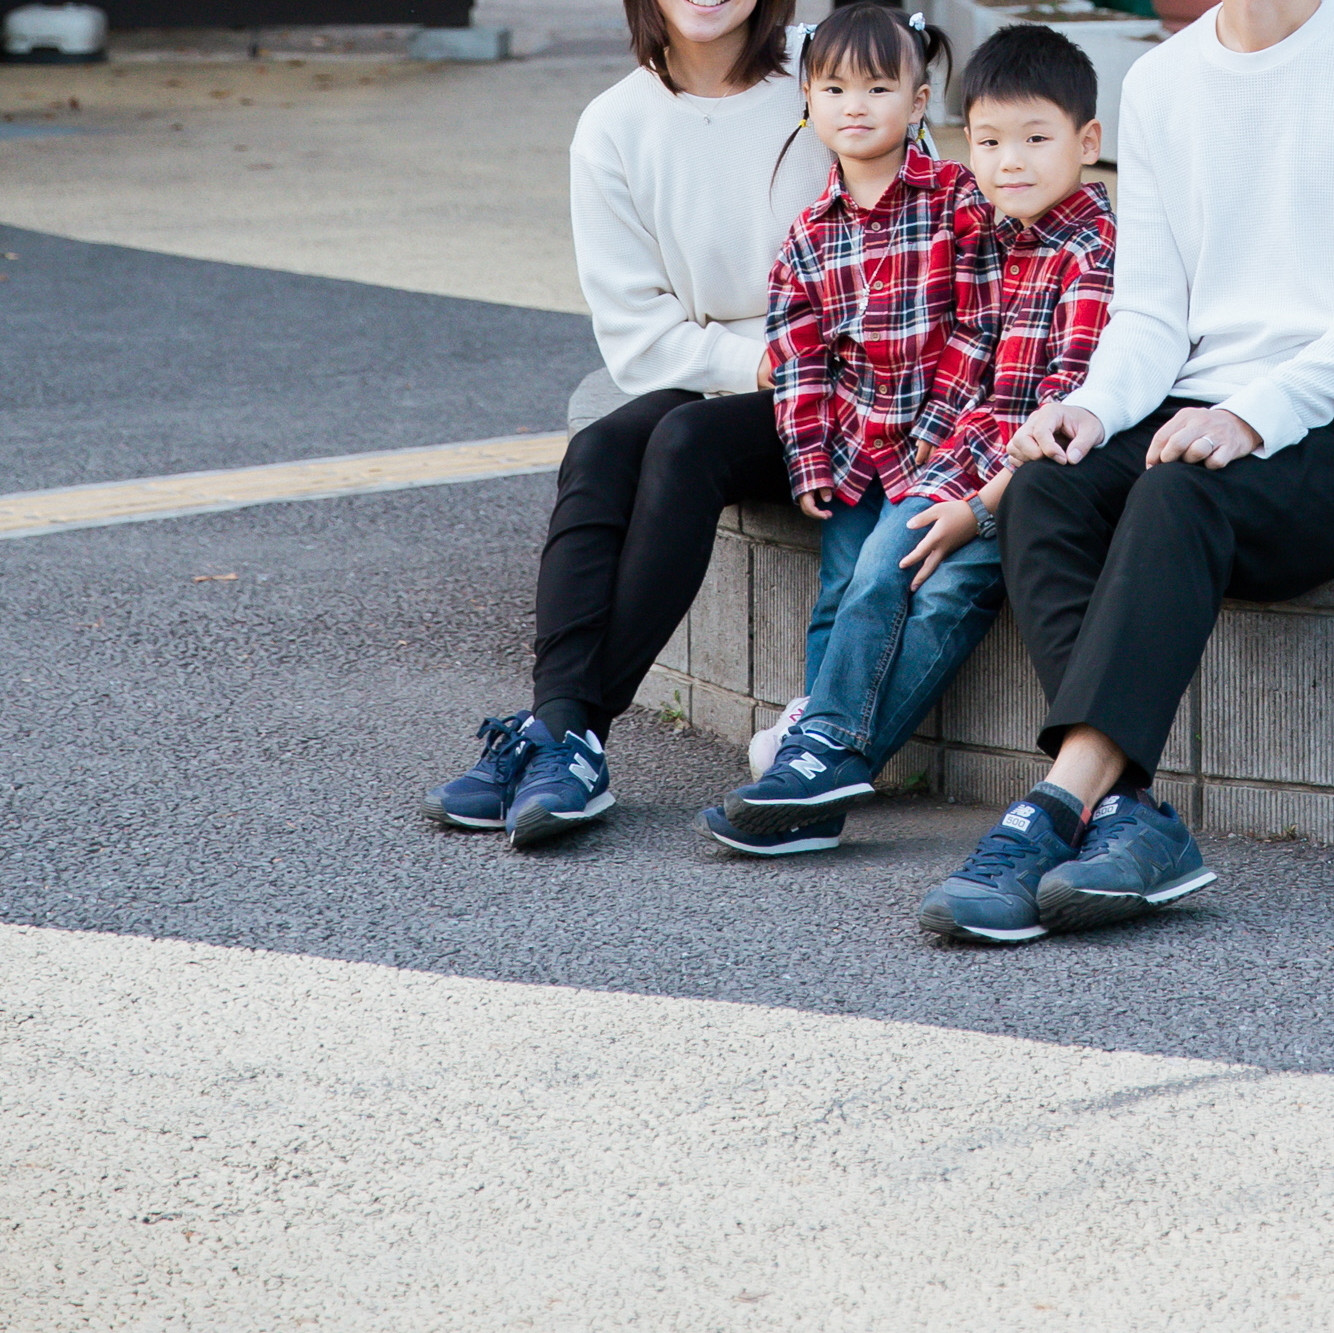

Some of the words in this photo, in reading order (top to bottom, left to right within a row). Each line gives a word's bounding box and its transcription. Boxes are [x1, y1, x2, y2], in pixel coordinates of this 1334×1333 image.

[568, 752, 599, 792] N
[788, 751, 827, 780] N
[1005, 815, 1026, 829] 500
